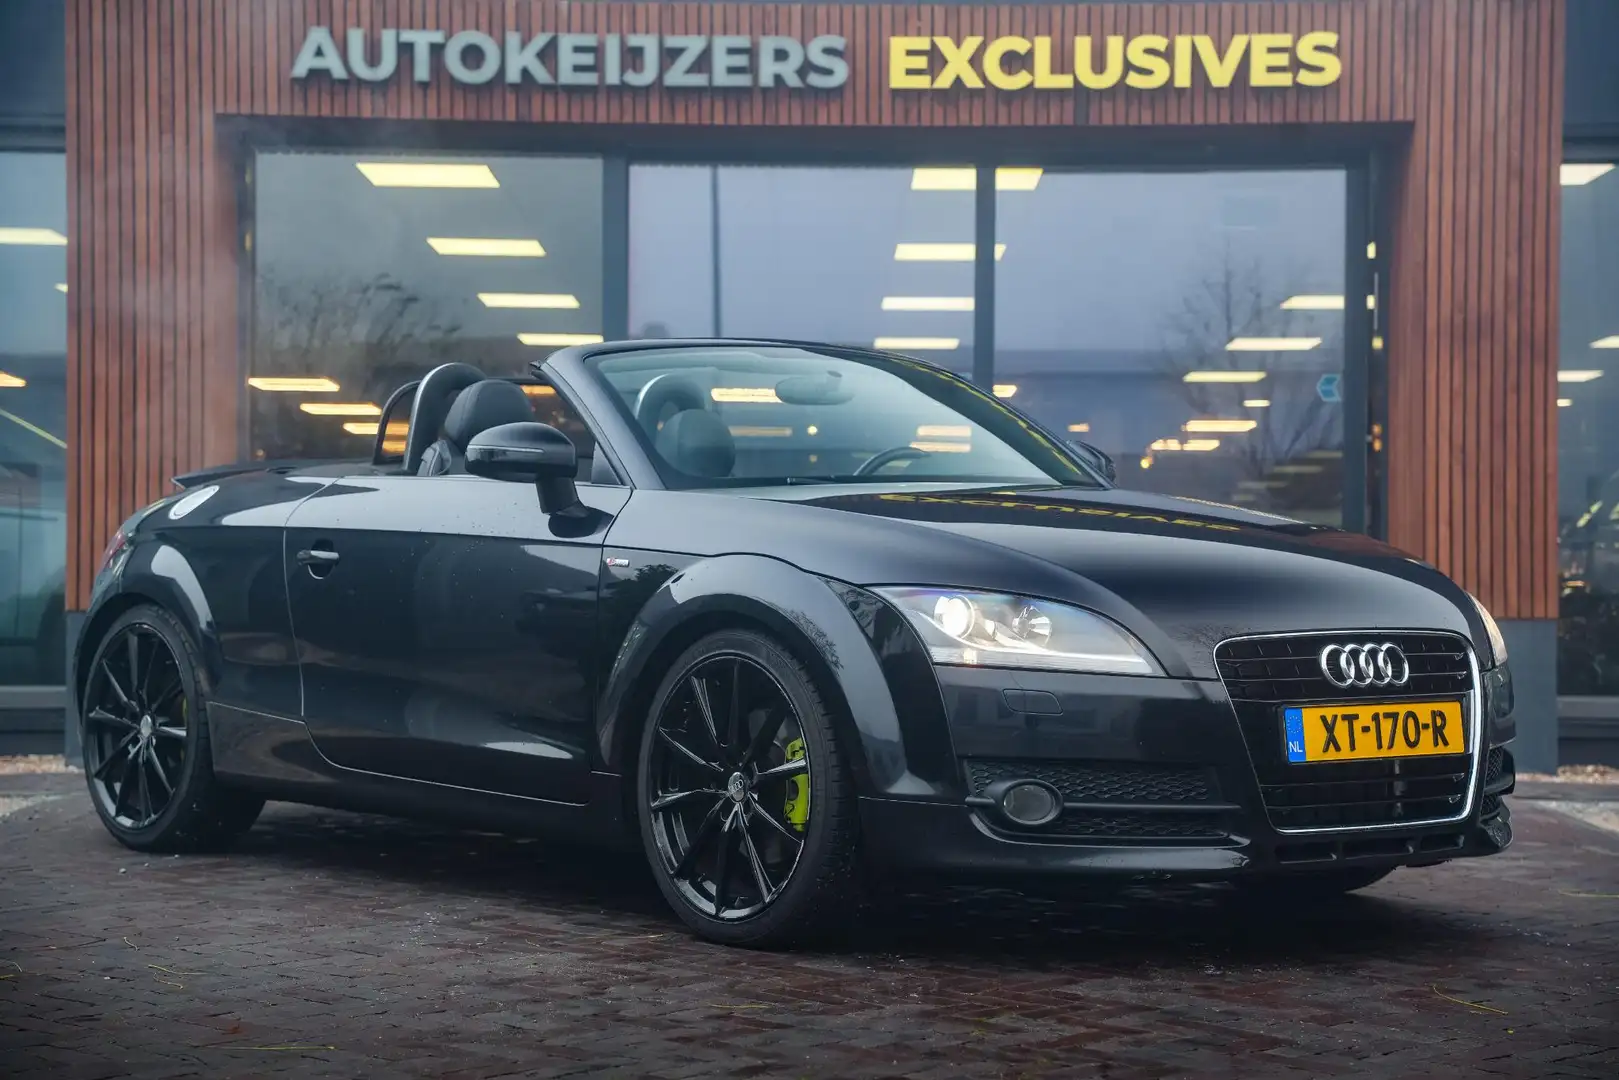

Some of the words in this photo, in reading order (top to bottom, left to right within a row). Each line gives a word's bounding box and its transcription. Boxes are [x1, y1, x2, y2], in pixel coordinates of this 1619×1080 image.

[291, 27, 849, 88] AUTOKEIJZERS
[889, 31, 1342, 90] EXCLUSIVES
[1288, 740, 1303, 753] NL
[1320, 709, 1449, 753] XT-170-R
